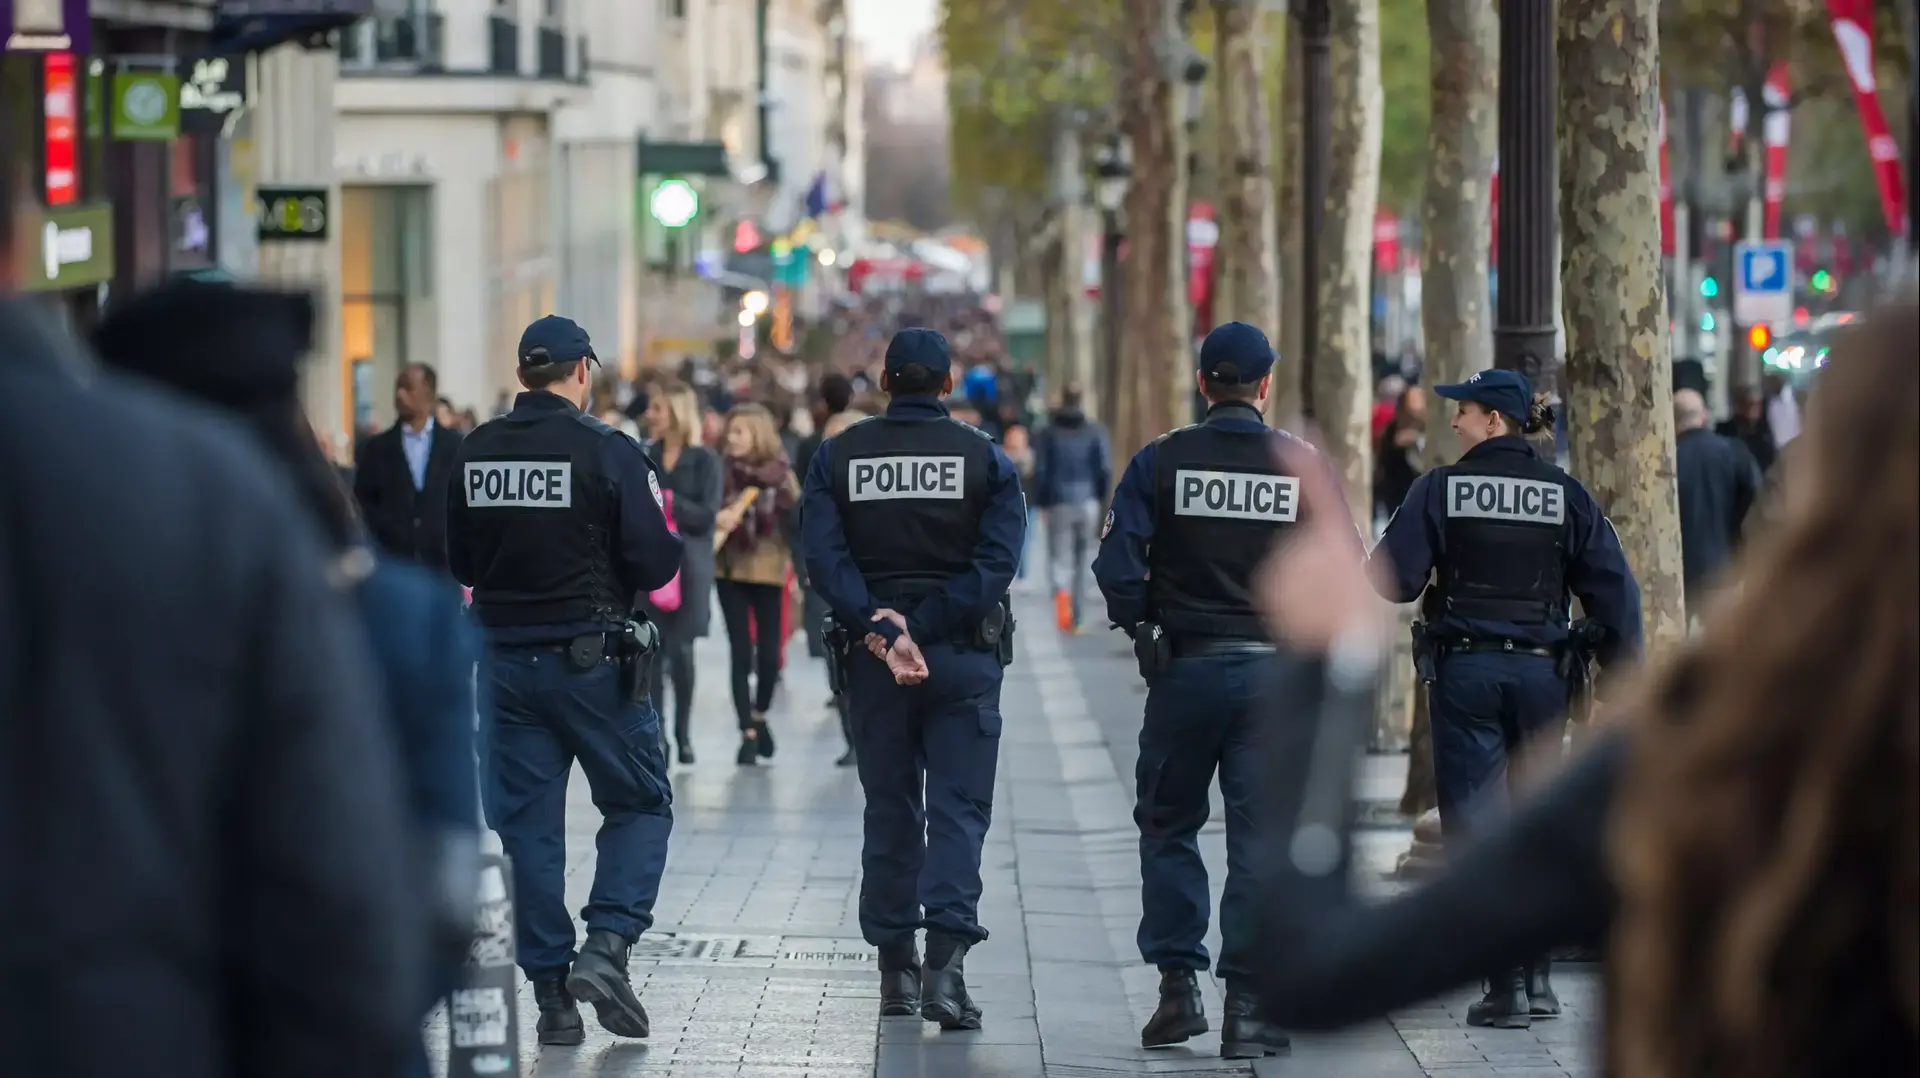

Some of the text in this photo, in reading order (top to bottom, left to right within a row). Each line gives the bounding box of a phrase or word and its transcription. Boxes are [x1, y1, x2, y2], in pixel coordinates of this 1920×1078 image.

[1749, 253, 1776, 288] P
[468, 468, 564, 502] POLICE
[855, 461, 957, 495] POLICE
[1182, 476, 1292, 515] POLICE
[1454, 481, 1559, 518] POLICE
